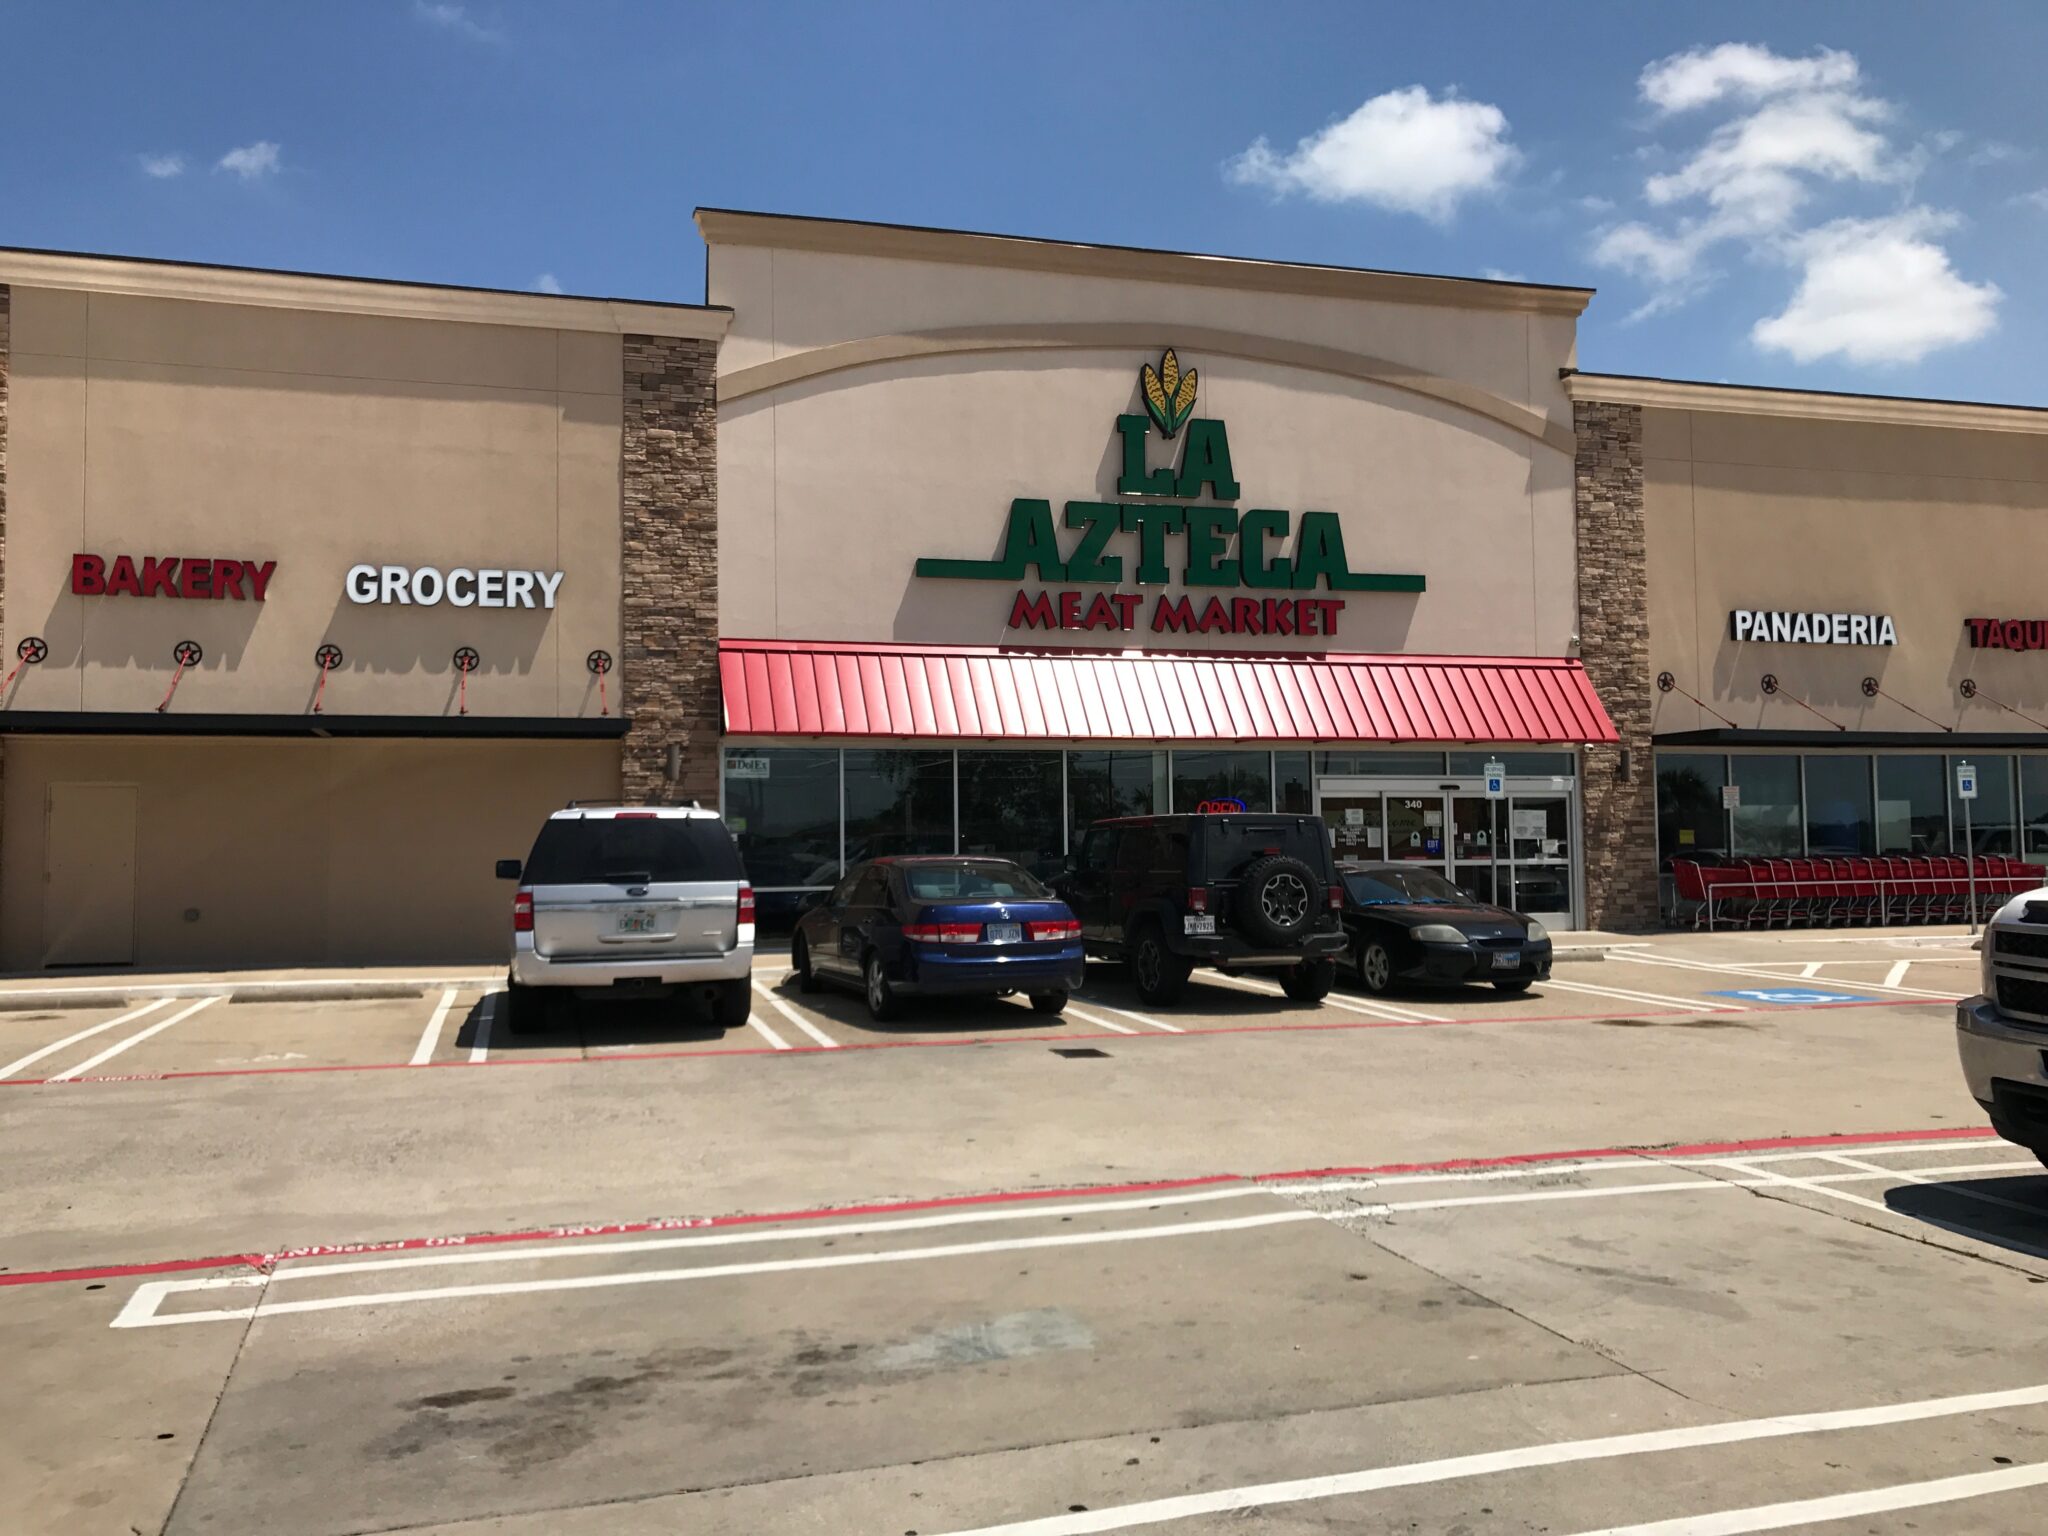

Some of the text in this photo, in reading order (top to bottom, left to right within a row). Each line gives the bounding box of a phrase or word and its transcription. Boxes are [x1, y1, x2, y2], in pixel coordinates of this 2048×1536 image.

[1117, 414, 1240, 500] LA
[1003, 498, 1350, 592] AZTECA
[72, 554, 277, 602] BAKERY
[345, 564, 565, 610] GROCERY
[1008, 589, 1345, 638] MEAT MARKET
[1730, 609, 1898, 646] PANADERIA
[1405, 800, 1423, 809] 340
[425, 1235, 466, 1247] NO
